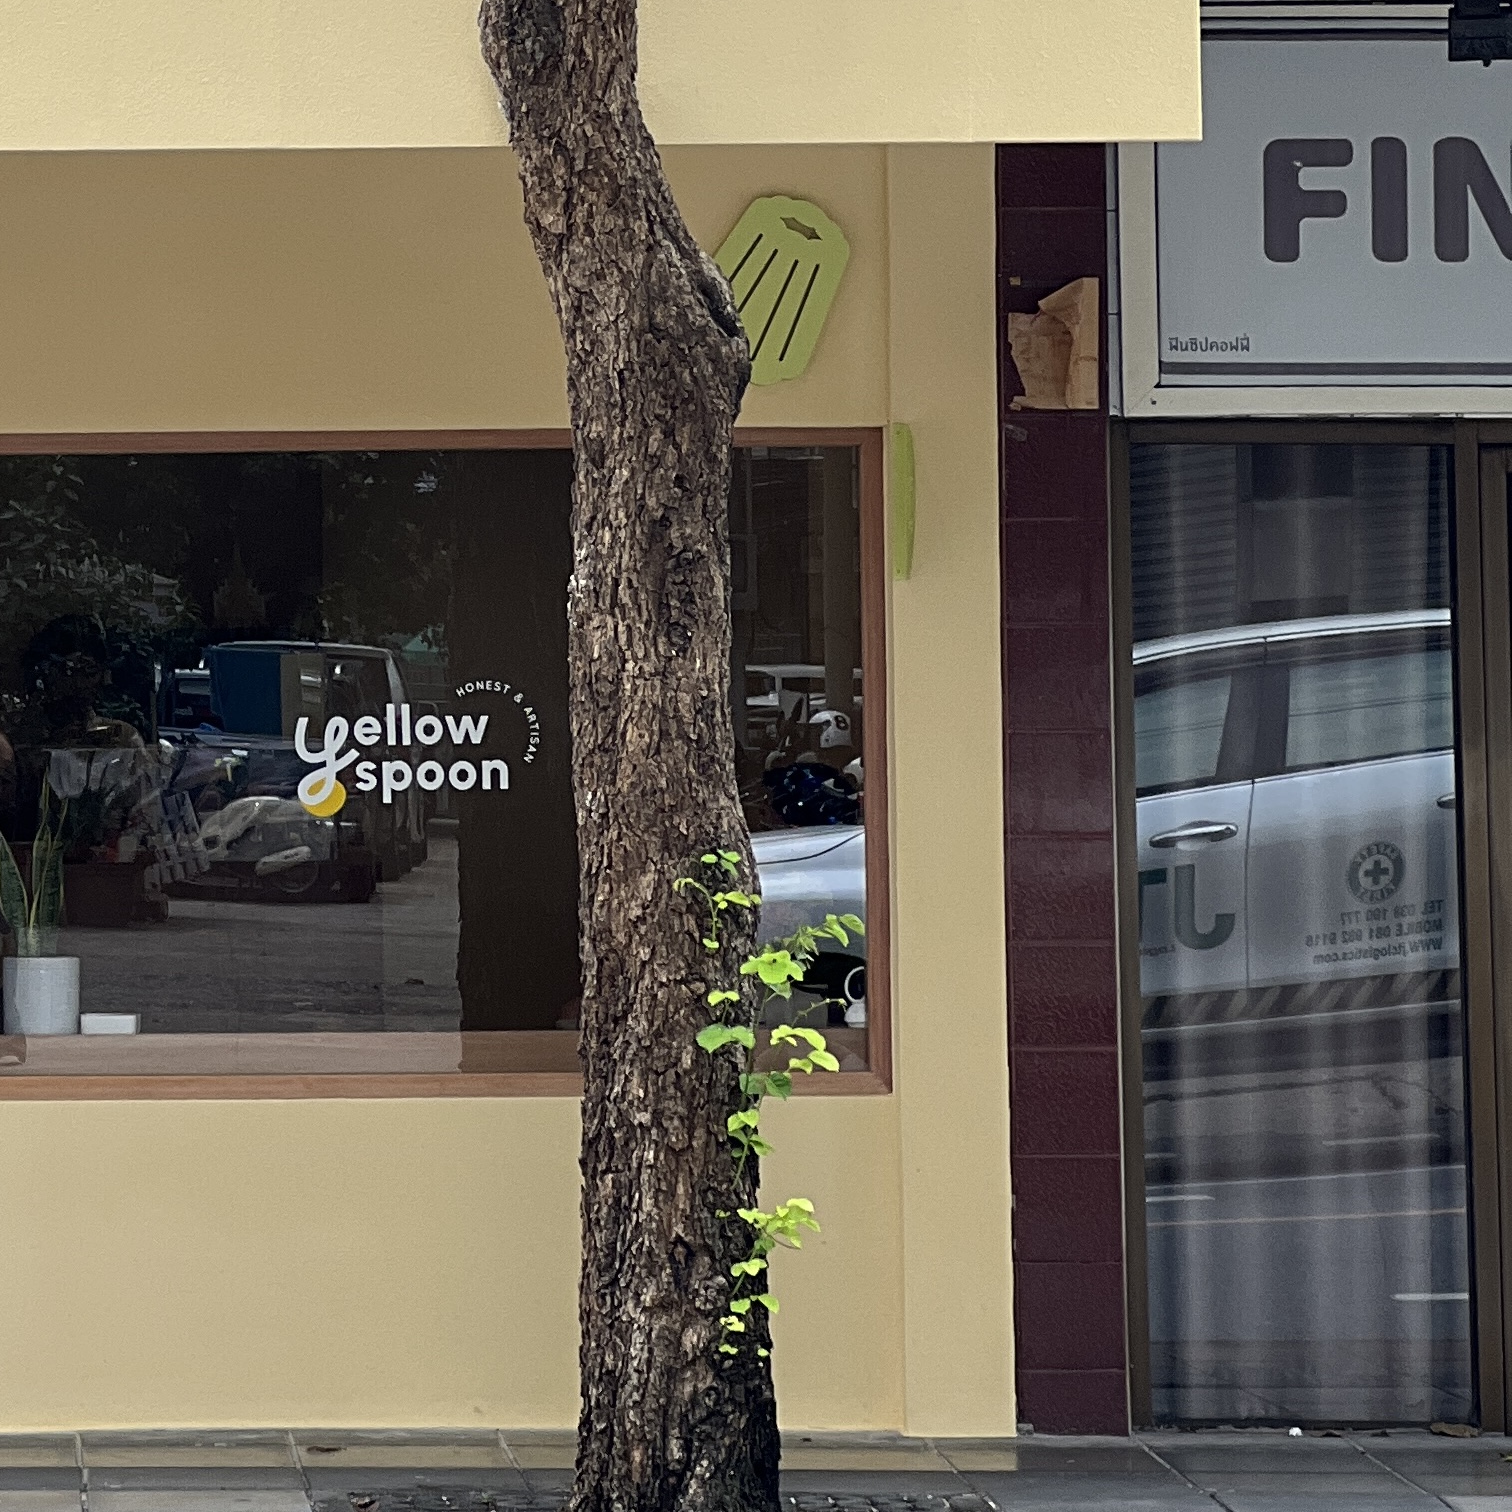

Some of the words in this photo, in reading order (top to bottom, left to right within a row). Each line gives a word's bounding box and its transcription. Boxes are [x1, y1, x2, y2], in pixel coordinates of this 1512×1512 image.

[1263, 136, 1512, 264] FIN
[456, 680, 510, 698] HONEST
[513, 692, 525, 704] &
[523, 705, 541, 764] ARTISAN
[355, 759, 509, 804] spoon
